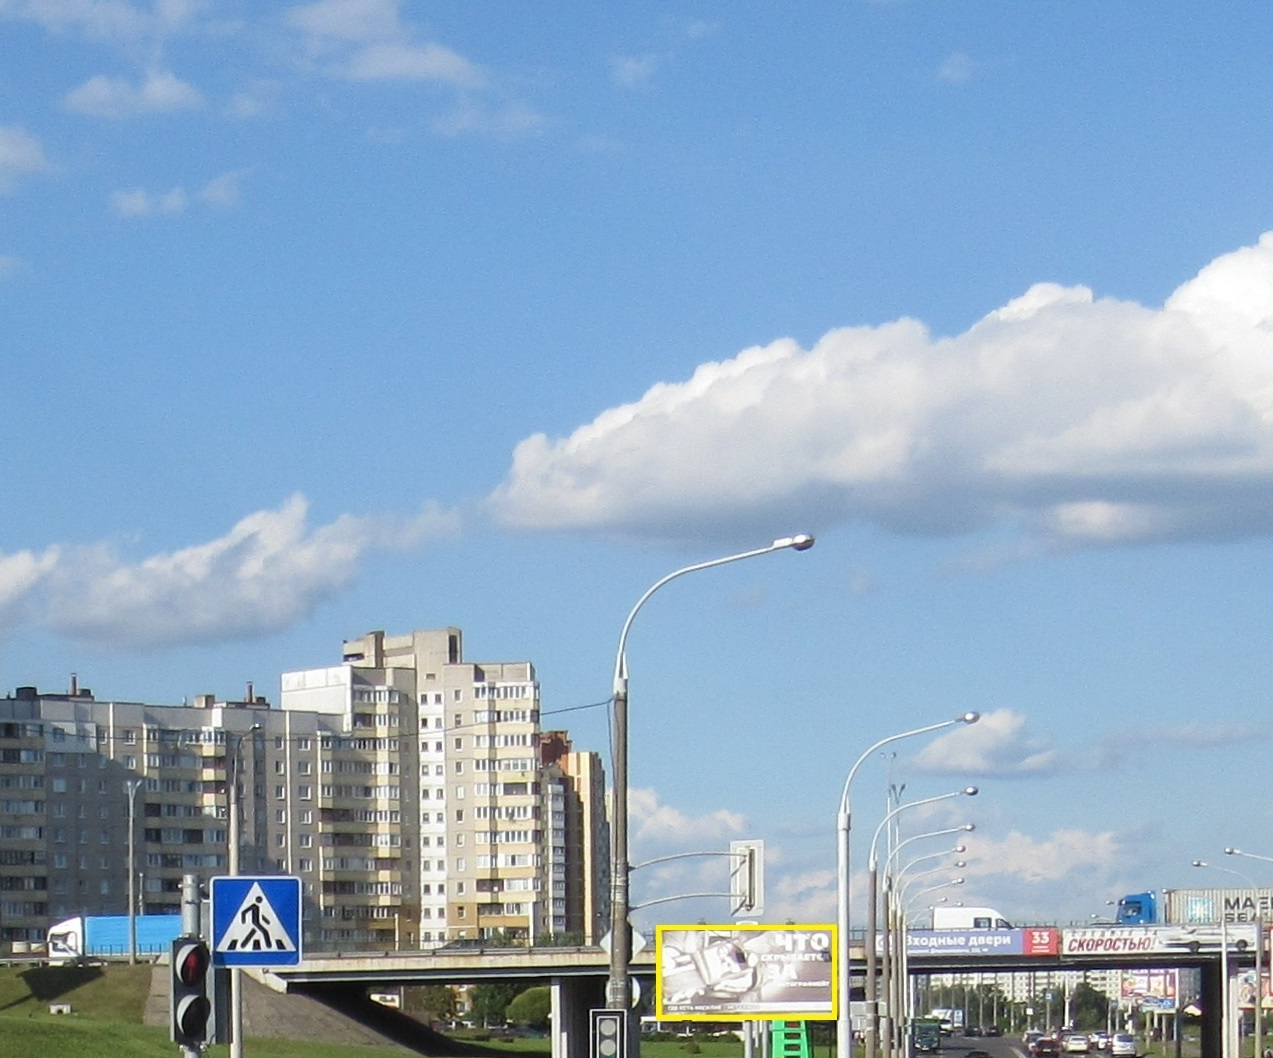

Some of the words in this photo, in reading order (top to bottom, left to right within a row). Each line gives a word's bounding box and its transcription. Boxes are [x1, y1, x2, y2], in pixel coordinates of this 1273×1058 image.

[775, 932, 829, 951] ЧТО
[968, 935, 1012, 948] двери
[1031, 931, 1050, 944] 33
[1068, 937, 1156, 953] СКОРОСТЬЮ!
